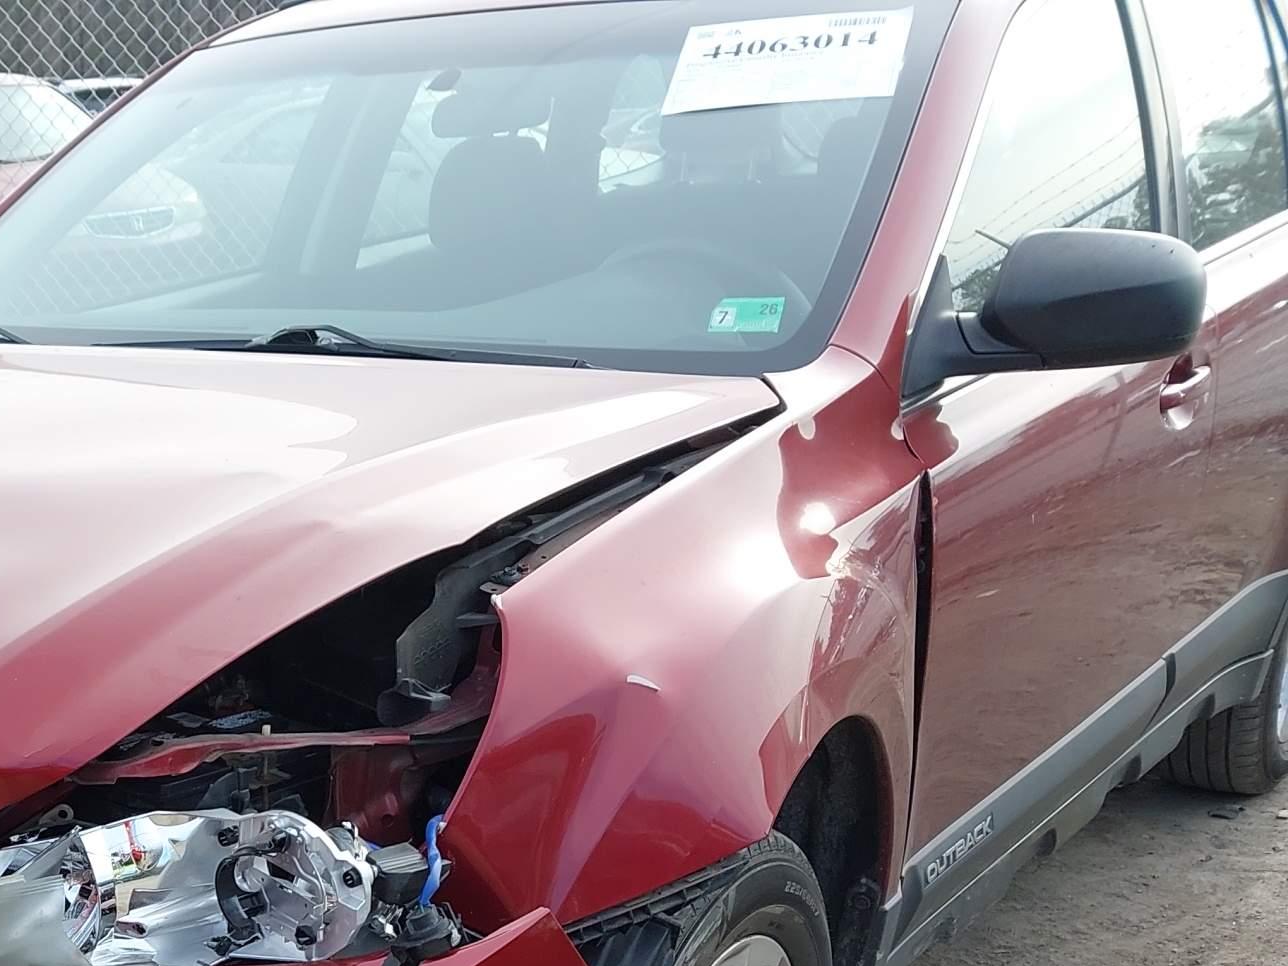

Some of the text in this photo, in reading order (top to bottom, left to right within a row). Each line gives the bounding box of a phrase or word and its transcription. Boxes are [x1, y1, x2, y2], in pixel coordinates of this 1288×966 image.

[702, 30, 878, 60] 44063014
[718, 310, 729, 325] 7
[759, 303, 779, 316] 26
[926, 814, 993, 883] OUTBACK
